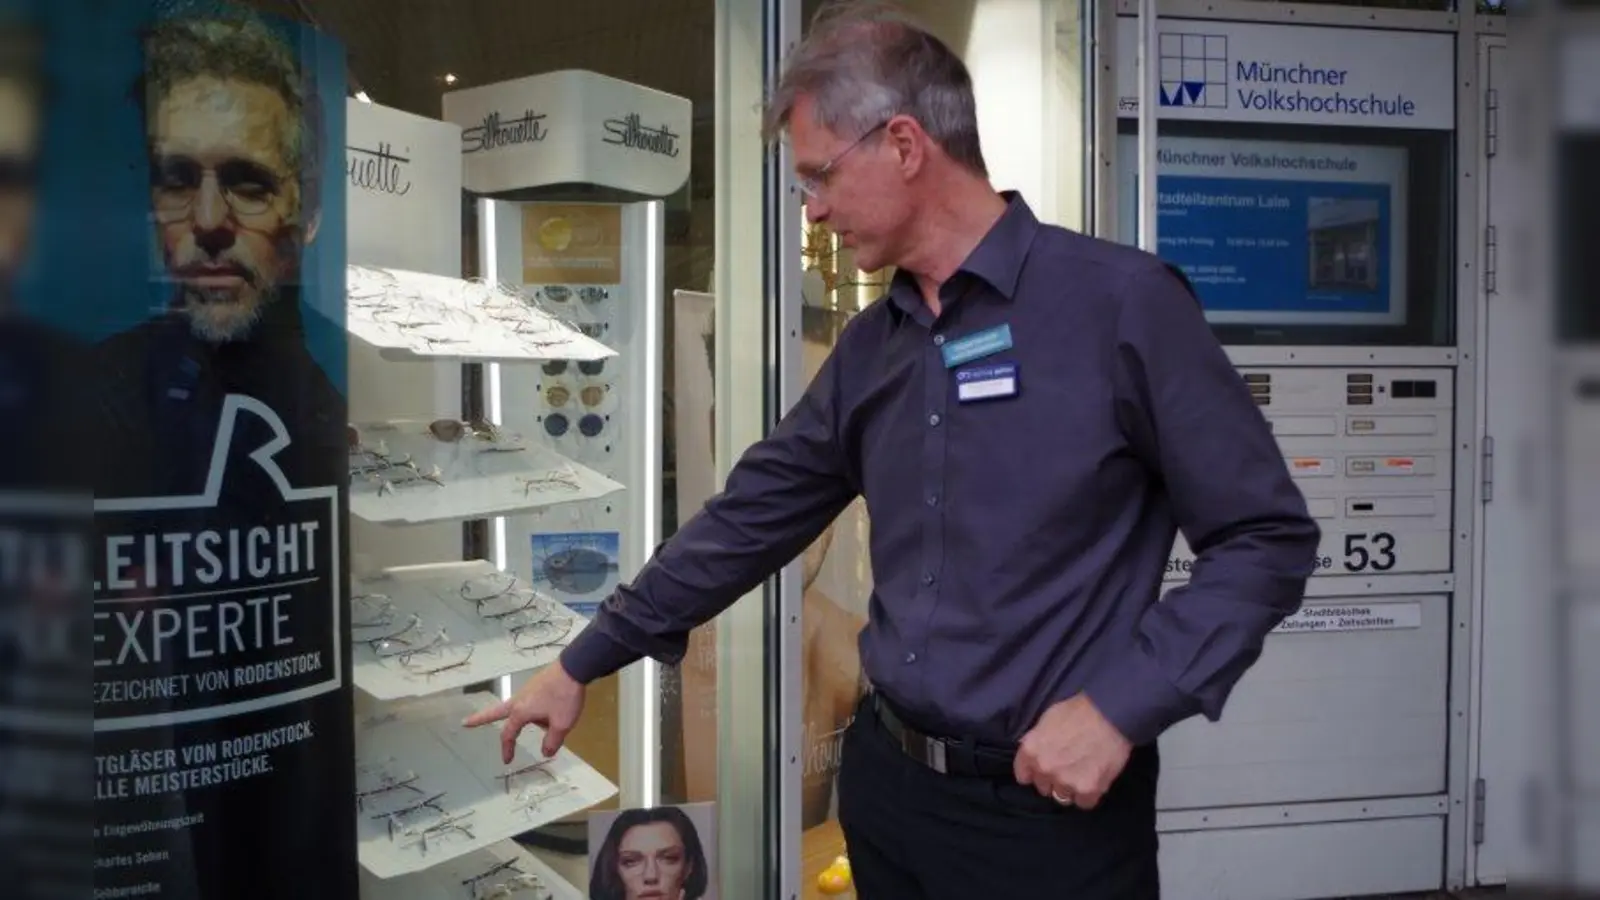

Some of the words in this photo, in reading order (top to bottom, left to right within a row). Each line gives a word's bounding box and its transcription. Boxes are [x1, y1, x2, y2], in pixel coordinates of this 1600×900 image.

[1236, 60, 1348, 86] Münchner
[1237, 88, 1416, 116] Volkshochschule
[461, 108, 548, 154] Silhouette
[602, 112, 680, 158] Silhouette
[1230, 151, 1358, 172] Volkshochschule
[94, 519, 320, 592] EITSICHT
[1344, 532, 1396, 573] 53
[195, 671, 230, 694] VON
[234, 651, 323, 687] RODENSTOCK
[94, 748, 177, 775] TGLÄSER
[181, 742, 217, 766] VON
[134, 754, 275, 797] MEISTERSTÜCKE.
